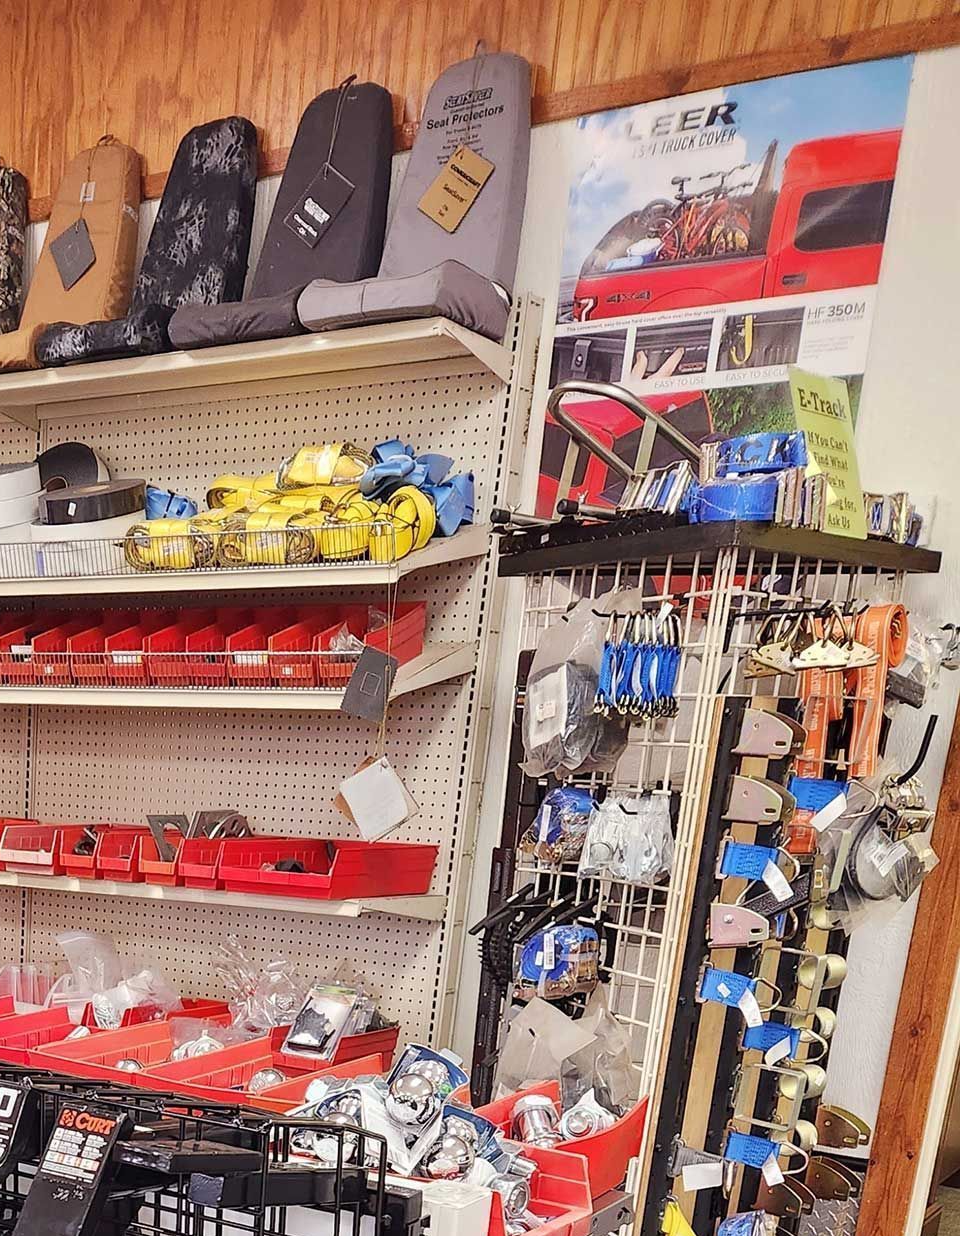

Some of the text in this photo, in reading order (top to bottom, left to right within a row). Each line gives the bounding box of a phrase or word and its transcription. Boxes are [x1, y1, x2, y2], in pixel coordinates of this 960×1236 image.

[427, 104, 504, 129] Seat Protectors
[624, 101, 738, 141] LEER
[660, 134, 697, 155] TRUCK
[698, 129, 736, 148] COVER
[808, 306, 826, 319] HF
[654, 380, 674, 389] EASY
[690, 377, 705, 385] USE
[726, 372, 747, 381] EASY
[750, 370, 761, 379] TO
[797, 388, 847, 420] E-Track
[807, 431, 849, 452] If You Can't
[814, 452, 849, 471] Find What
[828, 514, 851, 529] Ask Us
[74, 1111, 117, 1136] CURT
